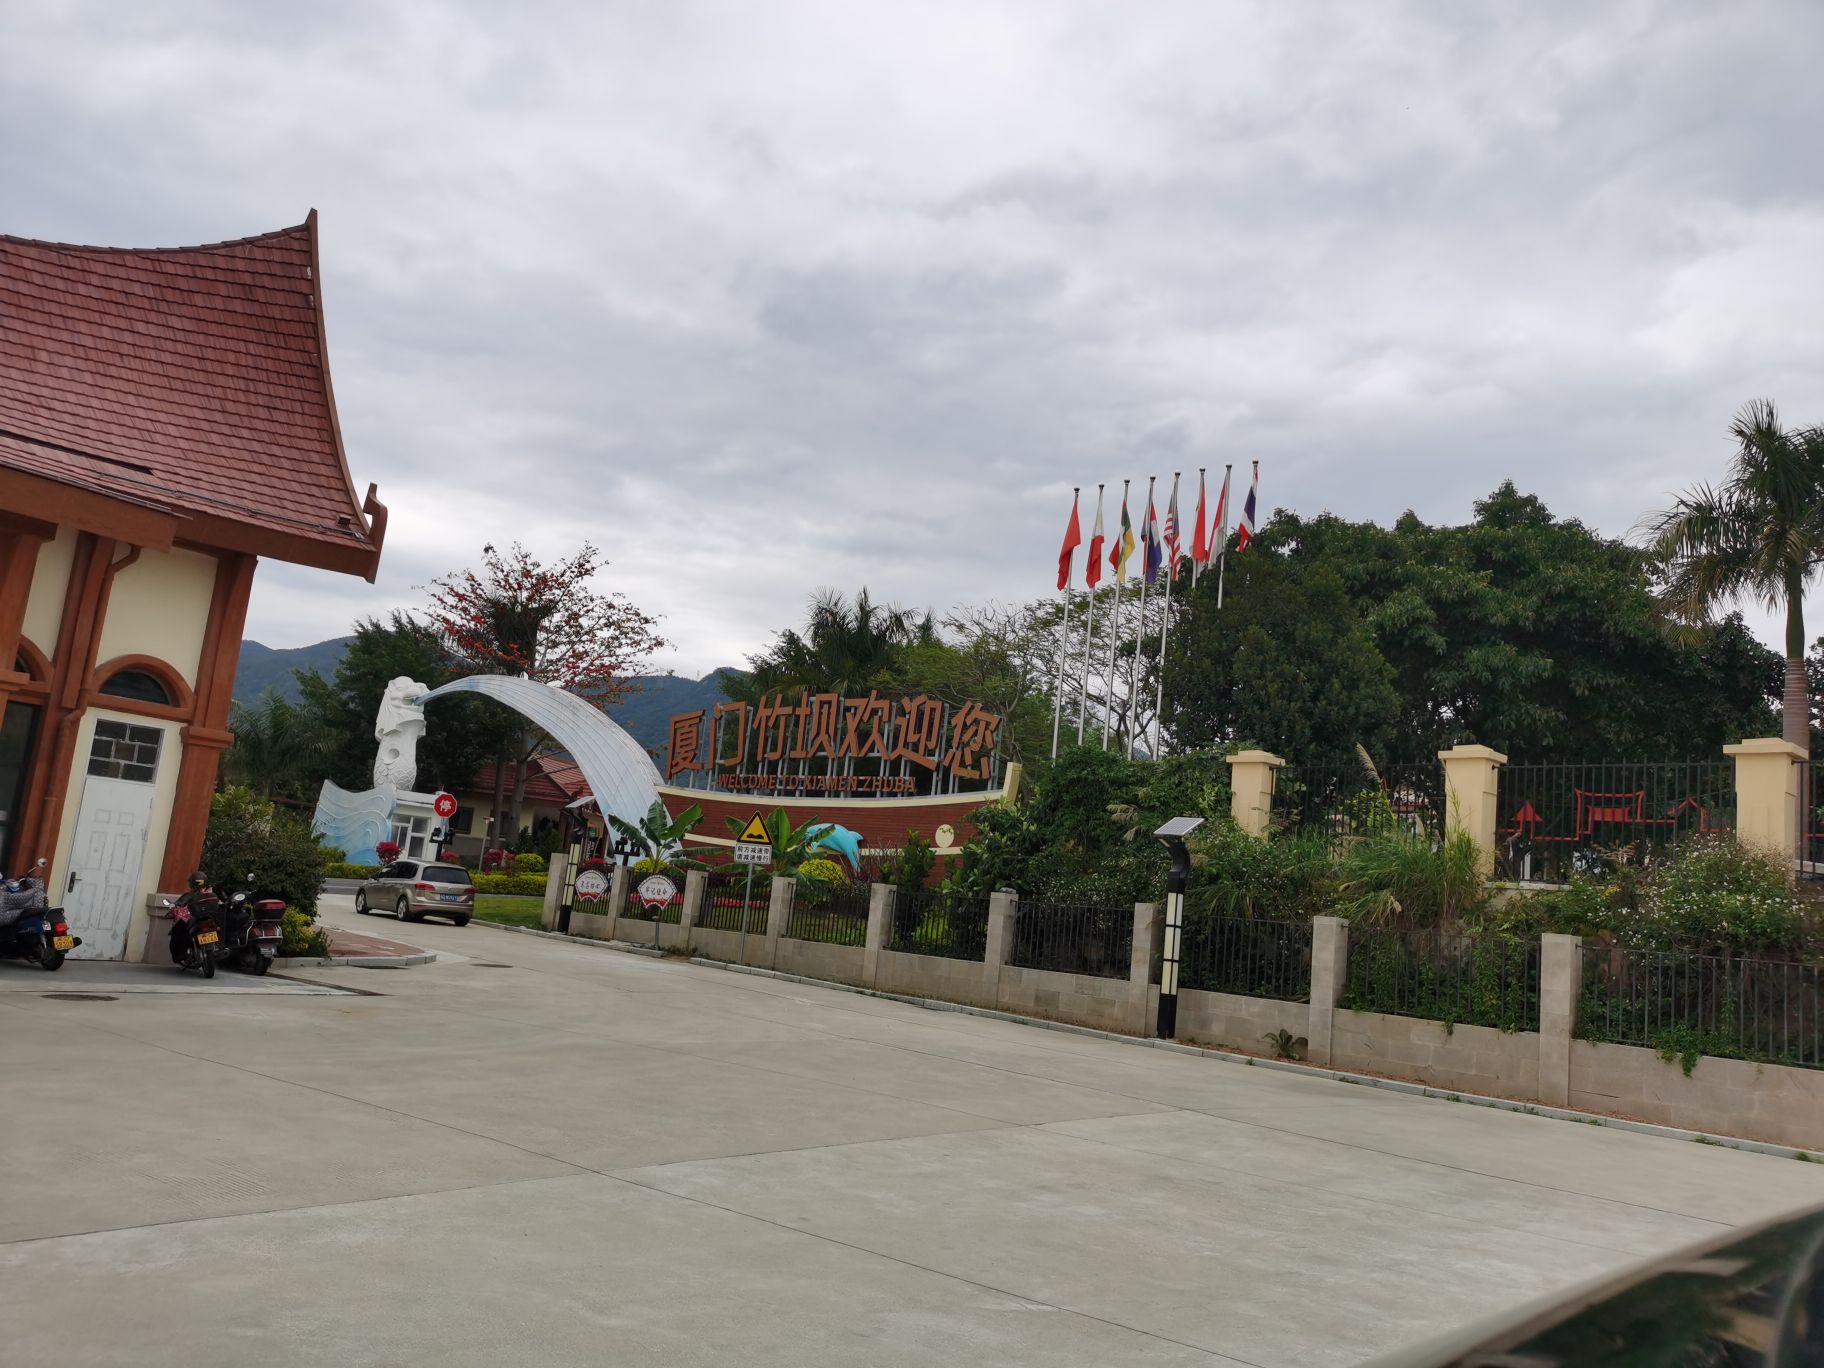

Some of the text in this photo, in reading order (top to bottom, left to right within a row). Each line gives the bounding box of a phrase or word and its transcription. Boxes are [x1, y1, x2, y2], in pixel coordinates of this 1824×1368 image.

[666, 690, 1001, 779] 厦门竹坝欢迎您
[718, 774, 917, 793] WELCOME TO XIAMEN ZHUBA
[439, 799, 452, 812] 停
